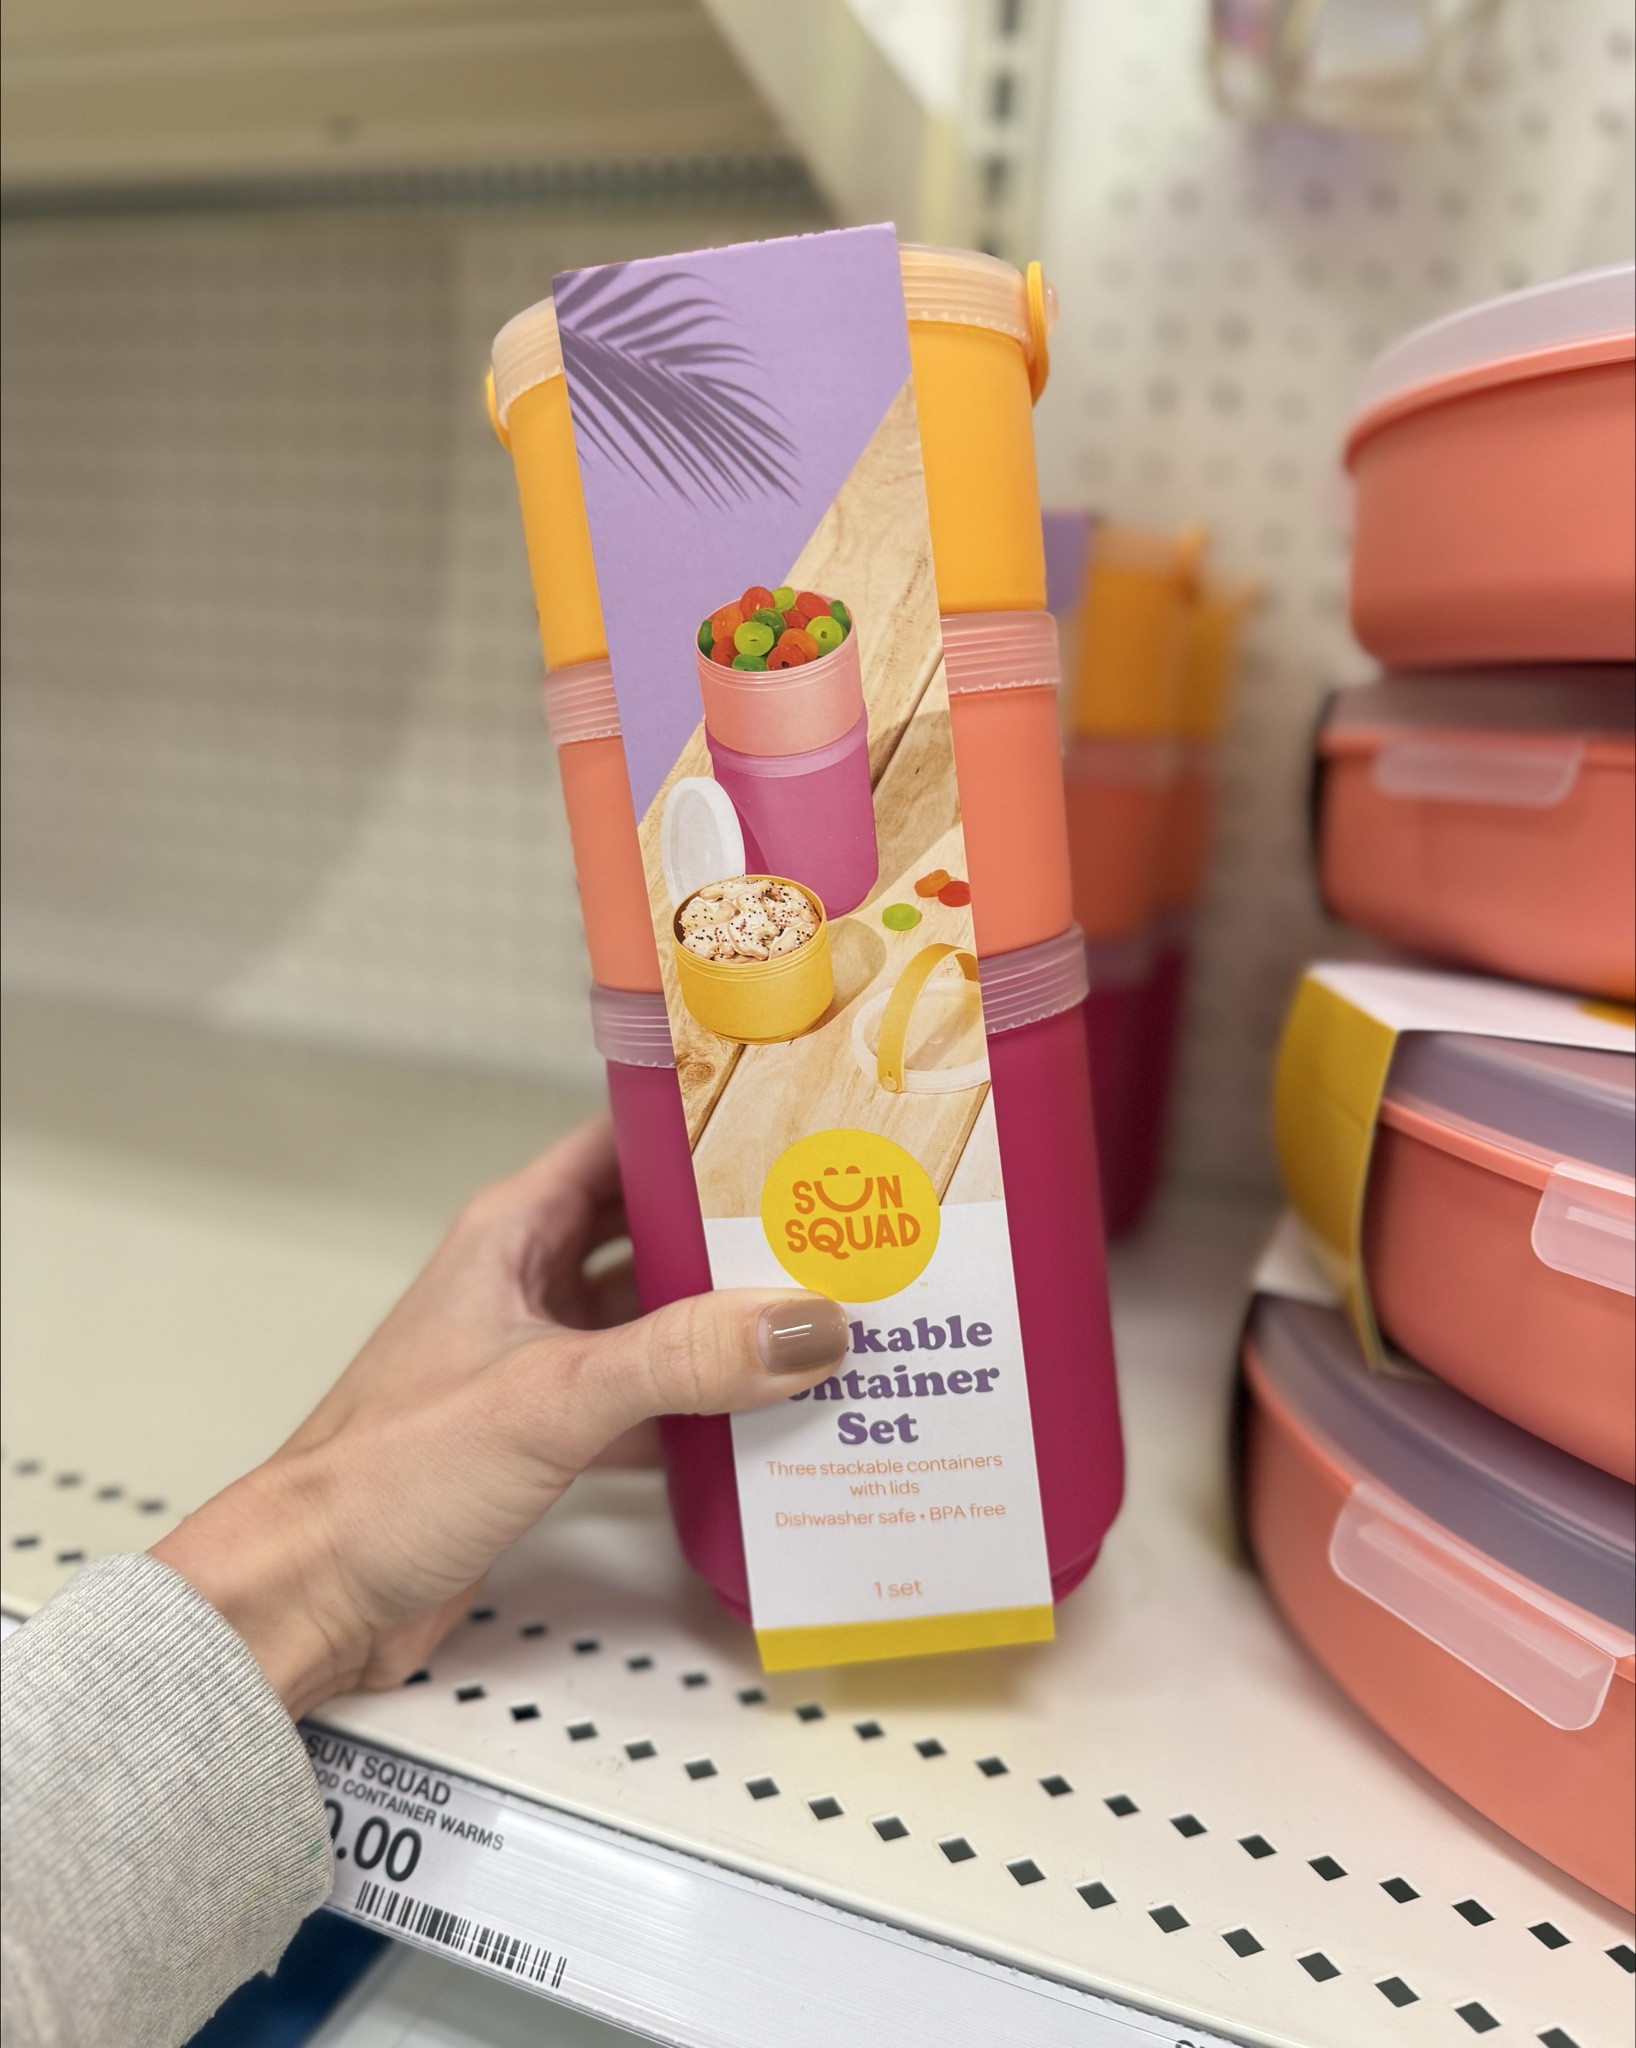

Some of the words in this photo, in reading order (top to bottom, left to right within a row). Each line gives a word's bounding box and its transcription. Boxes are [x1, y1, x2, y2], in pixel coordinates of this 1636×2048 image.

[793, 1170, 903, 1214] SUN
[785, 1212, 921, 1260] SQUAD
[846, 1314, 993, 1354] kable
[837, 1411, 919, 1445] Set
[766, 1459, 817, 1476] Three
[819, 1458, 904, 1476] stackable
[906, 1453, 1004, 1472] containers
[849, 1480, 887, 1497] with
[889, 1479, 921, 1495] lids
[774, 1509, 875, 1528] Dishwasher
[878, 1507, 916, 1525] safe
[929, 1504, 967, 1522] BPA
[969, 1501, 1007, 1518] free
[873, 1580, 883, 1598] 1
[888, 1578, 923, 1597] set
[306, 1735, 358, 1773] SUN
[361, 1755, 451, 1806] SQUAD
[314, 1768, 340, 1789] OD
[342, 1778, 437, 1826] CONTAINER
[440, 1814, 505, 1850] WARMS
